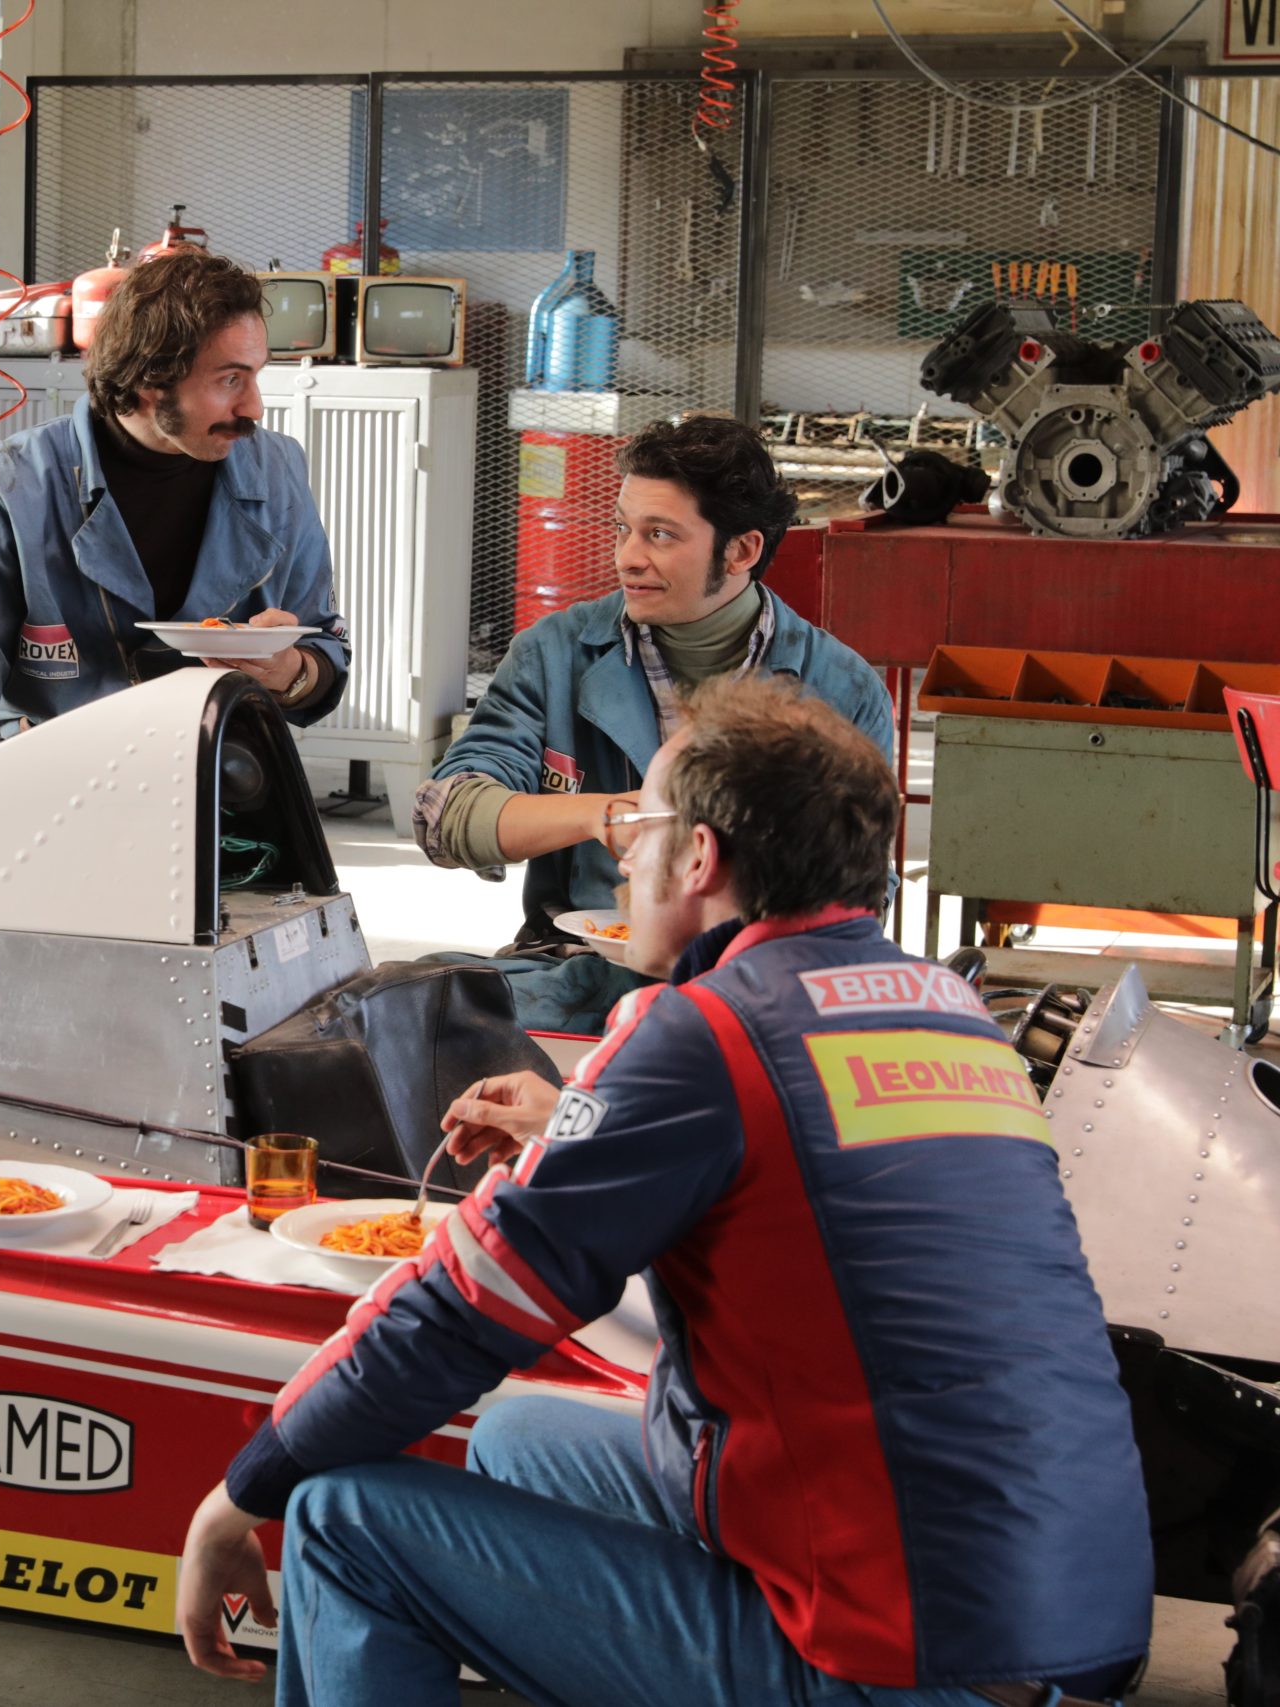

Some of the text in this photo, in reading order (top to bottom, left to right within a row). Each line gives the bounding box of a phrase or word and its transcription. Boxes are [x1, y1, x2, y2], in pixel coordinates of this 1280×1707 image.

[20, 639, 77, 660] ROVEX
[542, 766, 577, 792] ROV
[831, 964, 980, 1011] BRIXON
[241, 1626, 279, 1638] INNOVAT
